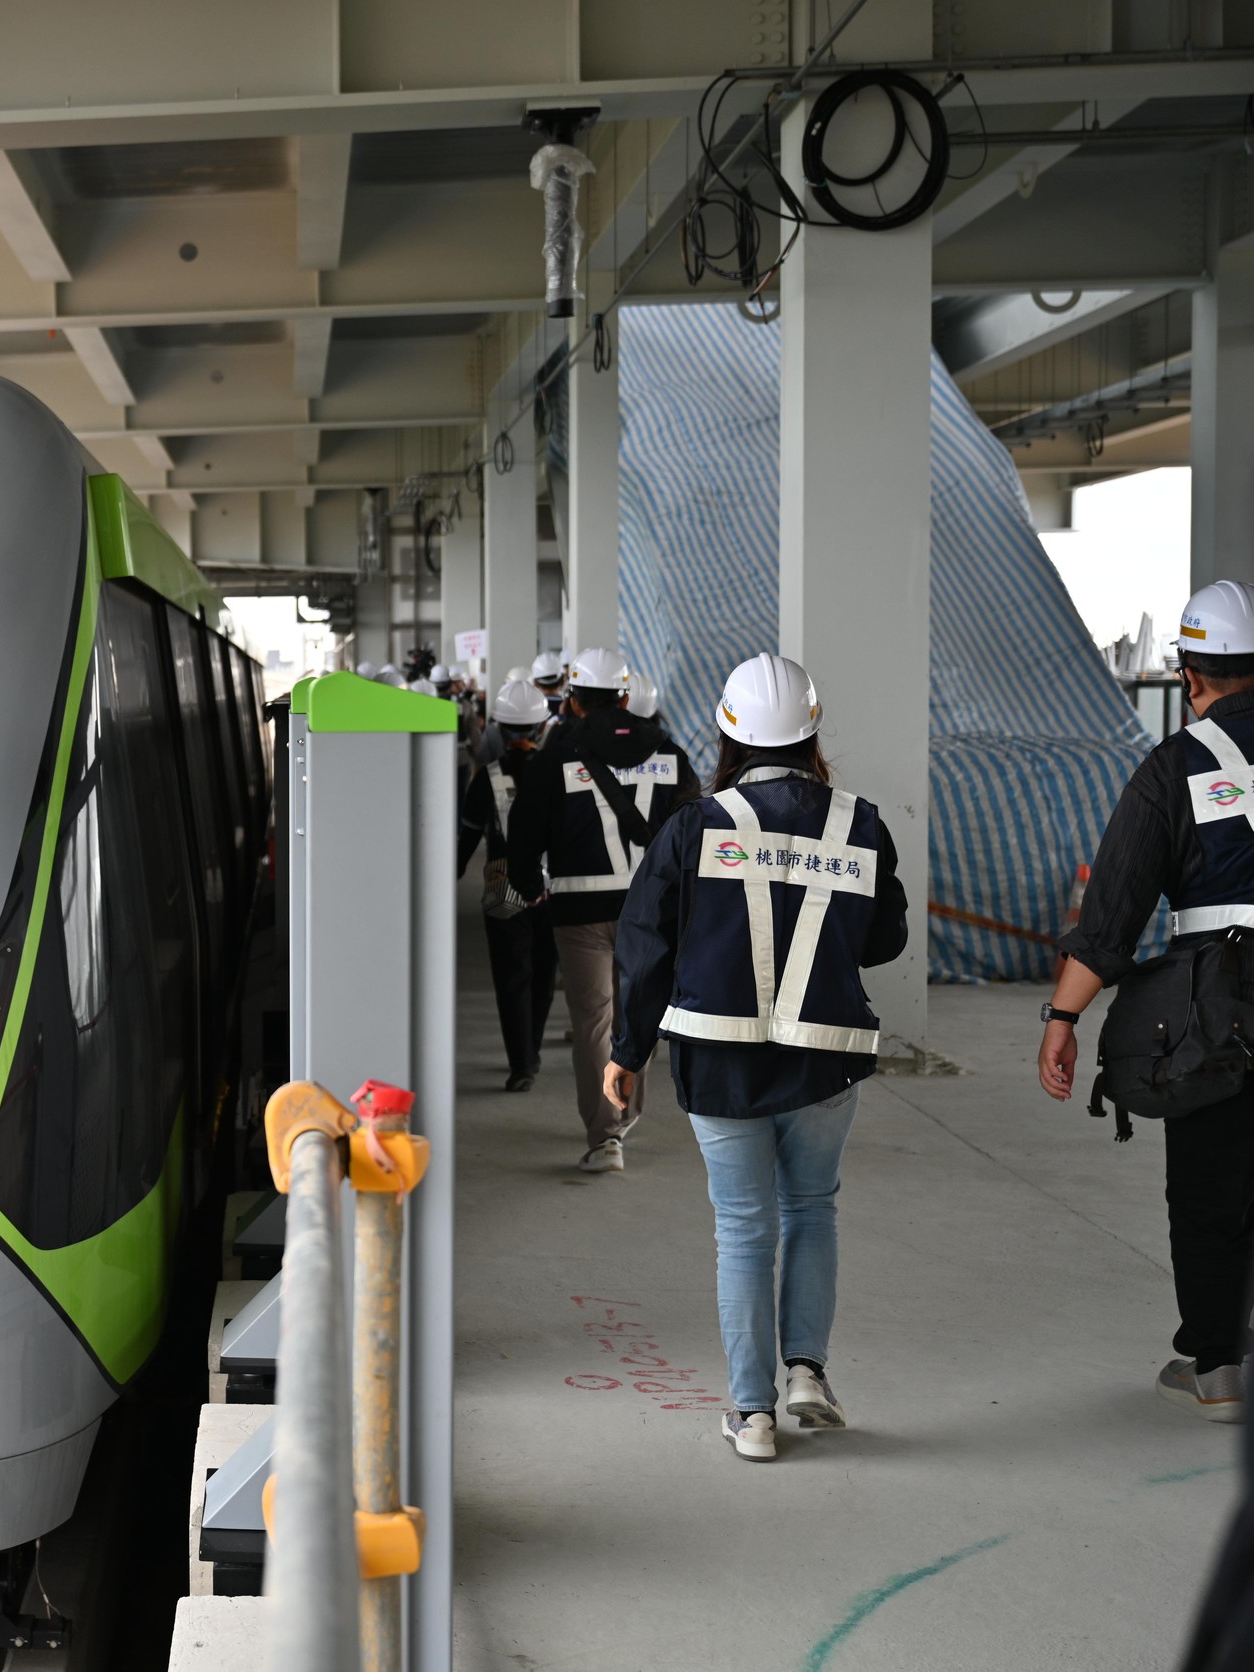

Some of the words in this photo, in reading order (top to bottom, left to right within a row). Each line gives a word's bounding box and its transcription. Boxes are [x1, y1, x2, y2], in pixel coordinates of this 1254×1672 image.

[755, 847, 861, 879] 桃園市捷運局
